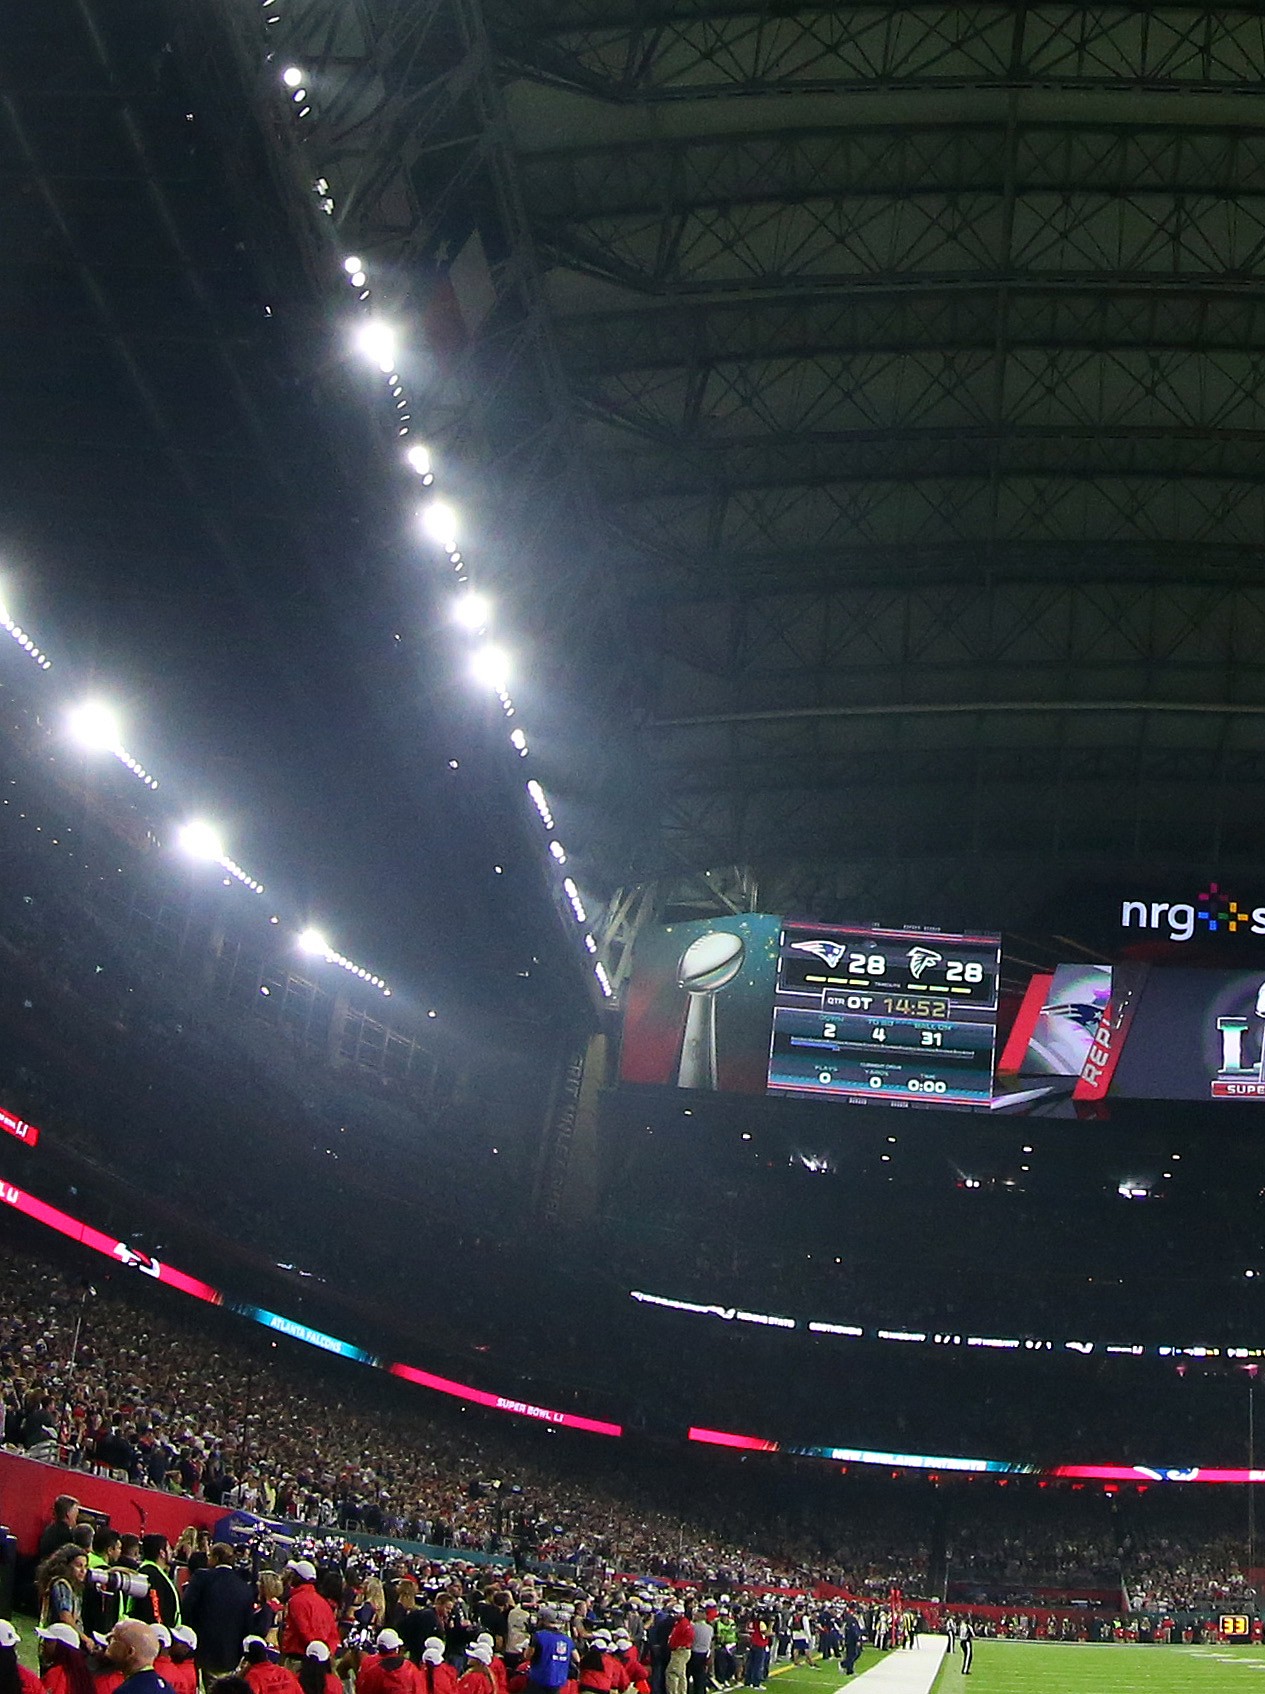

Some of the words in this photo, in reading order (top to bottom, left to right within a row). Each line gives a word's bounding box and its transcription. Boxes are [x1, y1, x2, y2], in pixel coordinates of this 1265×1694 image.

[1121, 900, 1195, 941] nrg
[849, 953, 886, 976] 28
[945, 961, 983, 983] 28
[827, 996, 846, 1006] QTR
[847, 996, 873, 1010] OT
[883, 998, 946, 1018] 14:52
[823, 1022, 836, 1038] 2
[872, 1027, 886, 1042] 4
[921, 1031, 942, 1046] 31
[819, 1071, 832, 1084] 0
[869, 1076, 882, 1088] 0
[907, 1078, 947, 1094] 0:00
[270, 1316, 306, 1341] ATLANTA
[306, 1330, 343, 1353] FALCONS
[496, 1397, 527, 1413] SUPER
[527, 1405, 551, 1420] BOWL
[1223, 1616, 1246, 1635] 33
